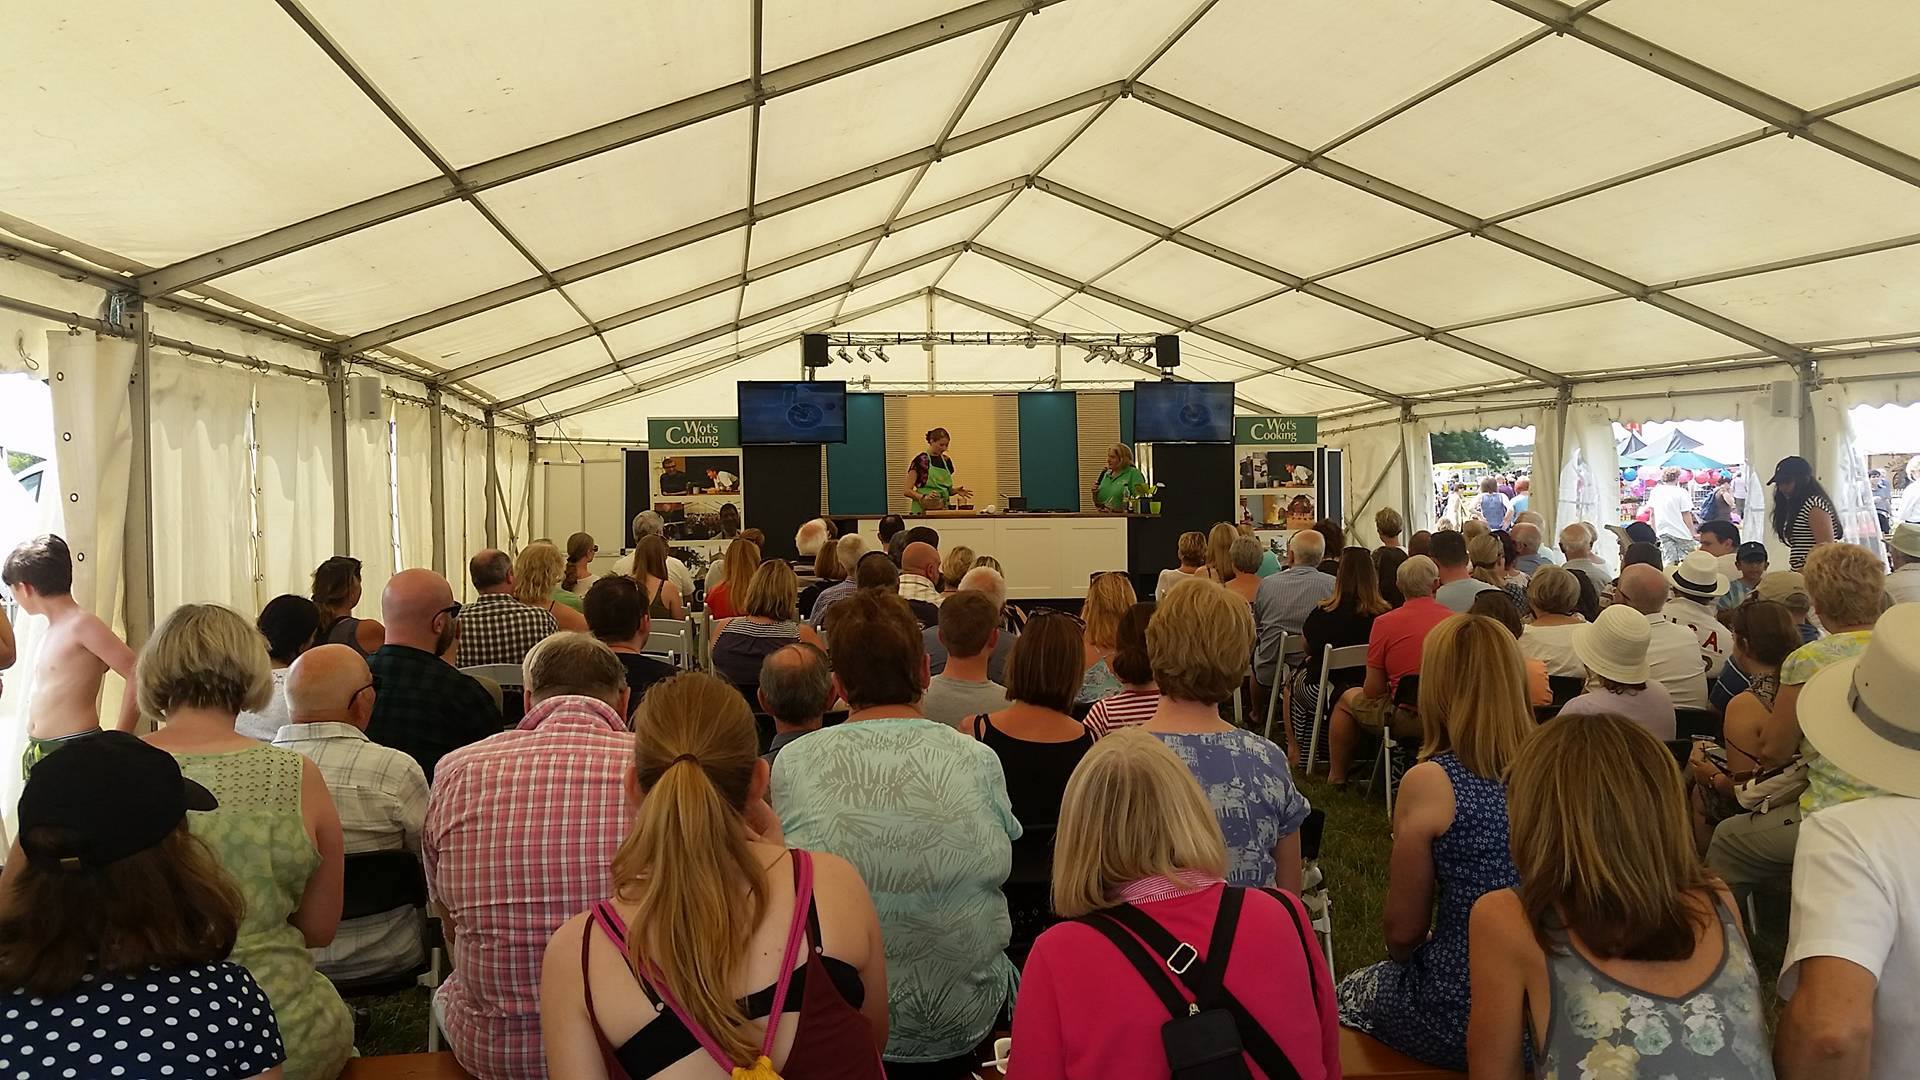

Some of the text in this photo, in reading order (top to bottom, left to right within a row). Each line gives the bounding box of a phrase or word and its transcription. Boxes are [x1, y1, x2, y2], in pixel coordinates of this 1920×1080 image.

[683, 420, 719, 434] Wot's
[1250, 423, 1297, 443] Cooking
[1266, 418, 1297, 431] Wot's
[665, 426, 719, 447] Cooking
